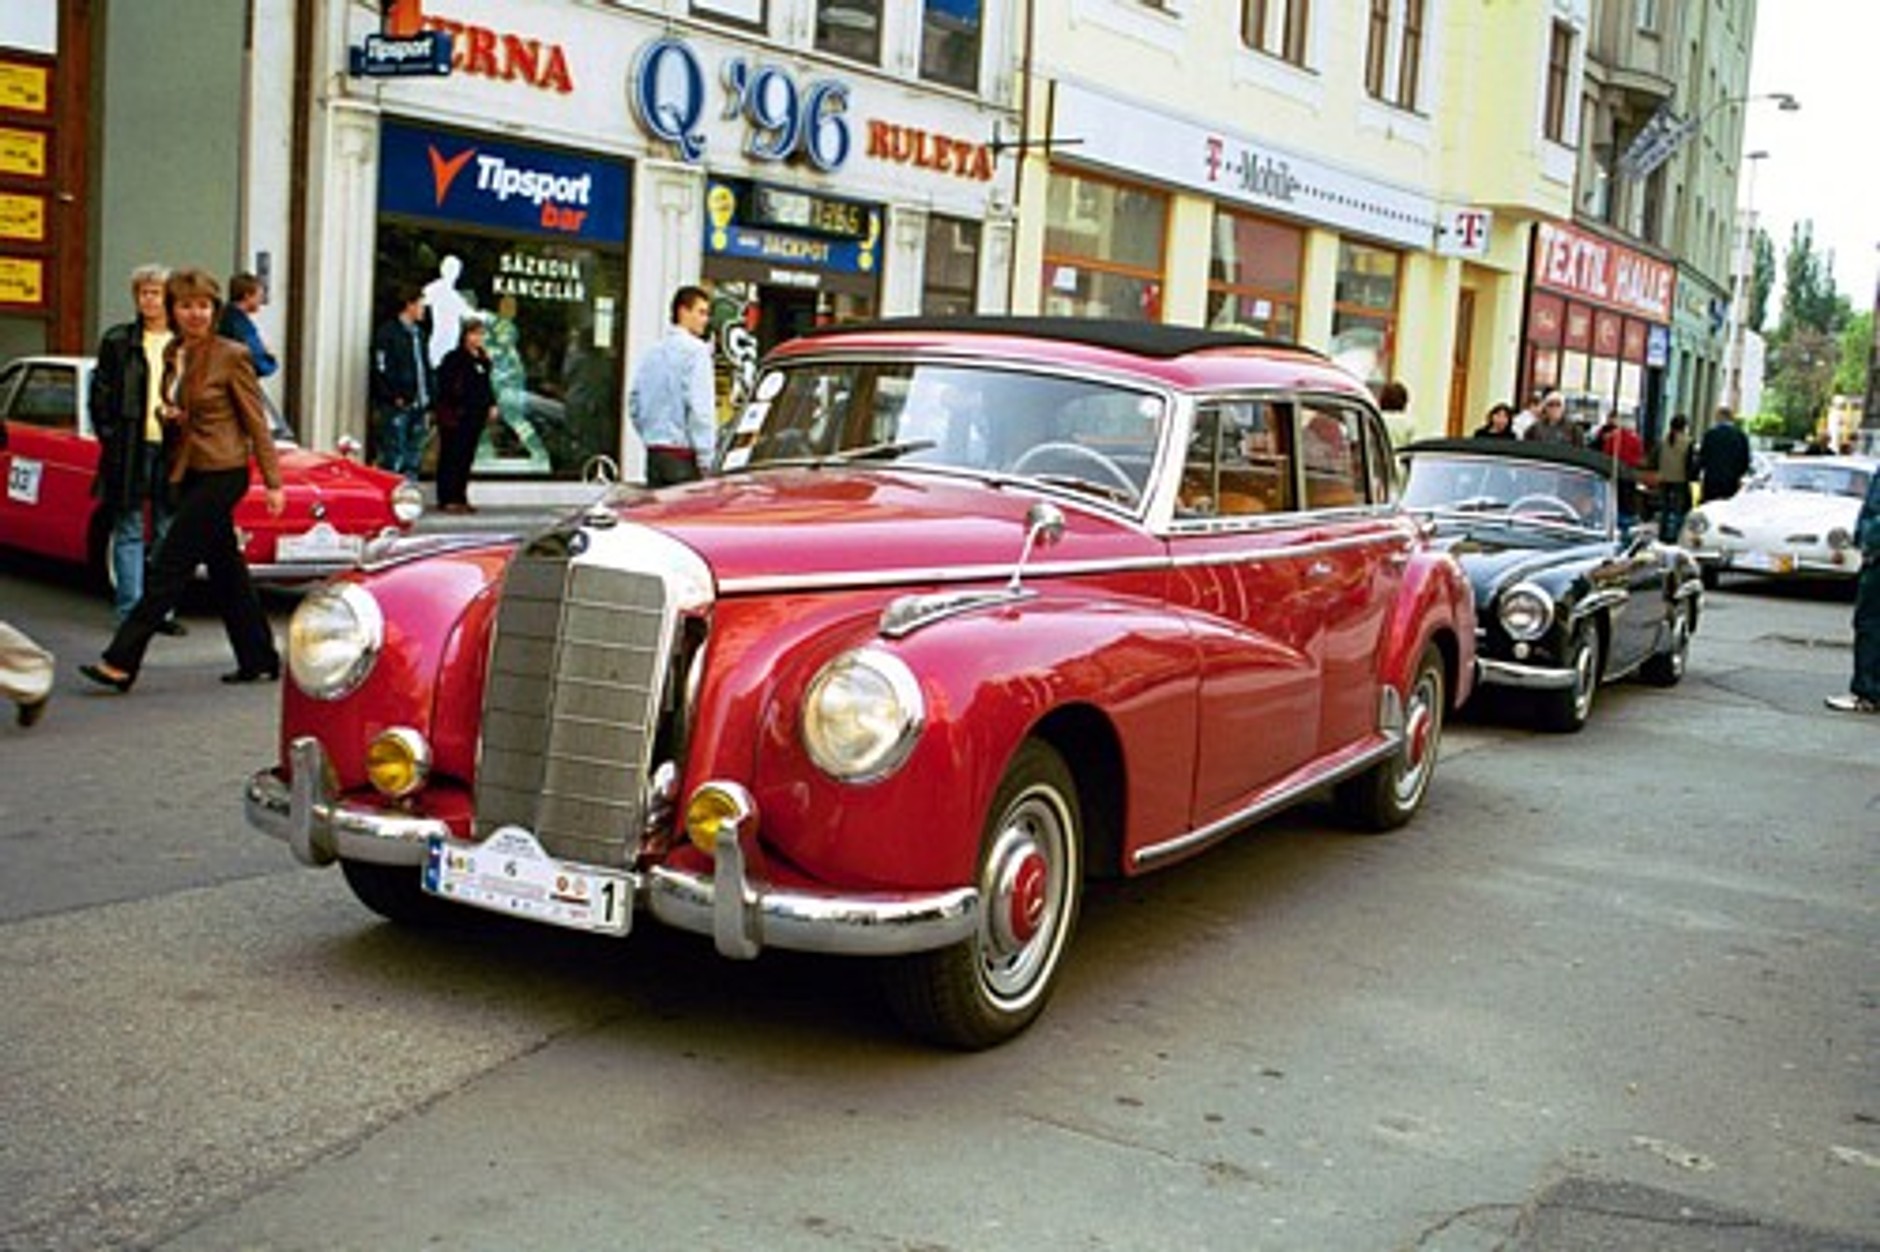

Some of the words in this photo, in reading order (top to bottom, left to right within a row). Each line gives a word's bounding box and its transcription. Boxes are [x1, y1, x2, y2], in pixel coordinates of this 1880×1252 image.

[630, 38, 706, 162] Q
[866, 118, 993, 182] RULETA
[477, 154, 592, 205] Tipsport
[540, 203, 587, 232] bar
[1539, 224, 1610, 299] TEXTIL
[601, 880, 616, 922] 1
